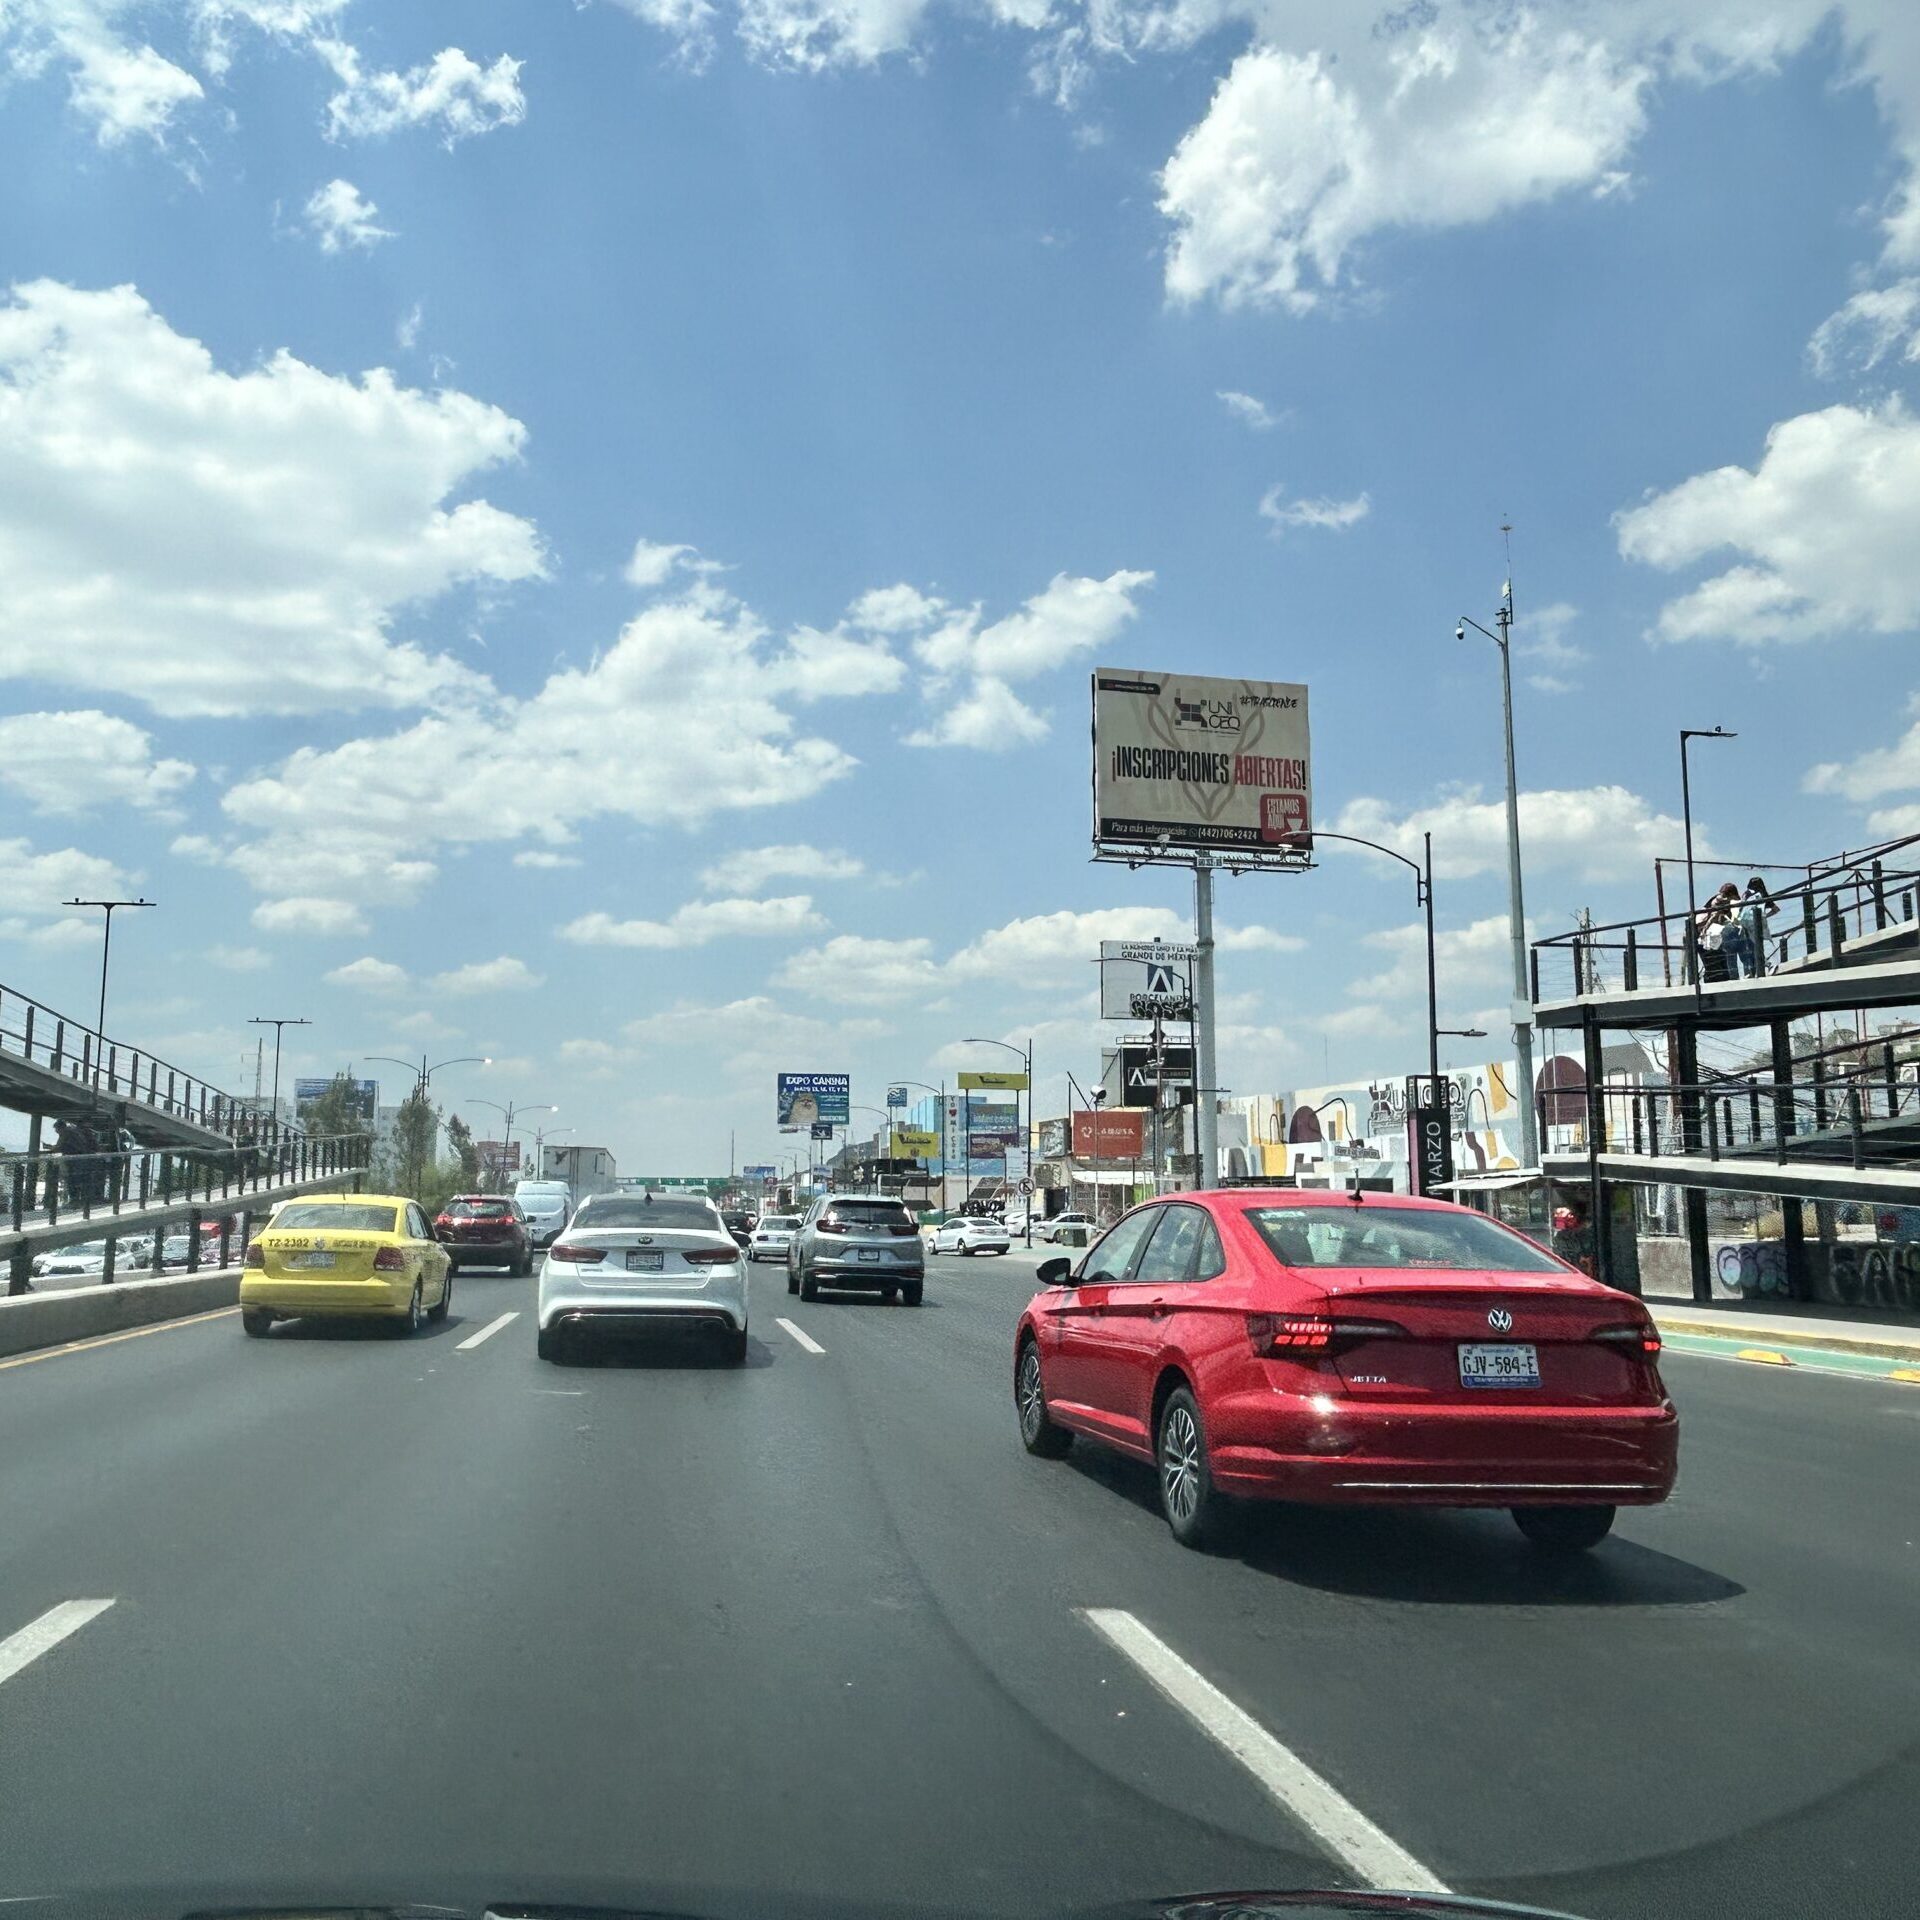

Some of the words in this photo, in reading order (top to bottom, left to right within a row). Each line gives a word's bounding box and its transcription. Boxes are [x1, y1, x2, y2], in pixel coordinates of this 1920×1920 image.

[1208, 699, 1233, 715] UNI
[1208, 714, 1241, 732] CEQ
[1112, 745, 1229, 784] ¡INSCRIPCIONES
[1234, 754, 1307, 790] ABIERTAS!
[1266, 798, 1300, 814] ESTAMOS
[1111, 821, 1128, 832] Para
[1129, 823, 1143, 833] más
[1122, 951, 1153, 960] GRANDE
[1156, 953, 1165, 961] DE
[786, 1076, 811, 1085] EXPO
[812, 1076, 848, 1086] CANINA
[1350, 1375, 1387, 1384] JETTA
